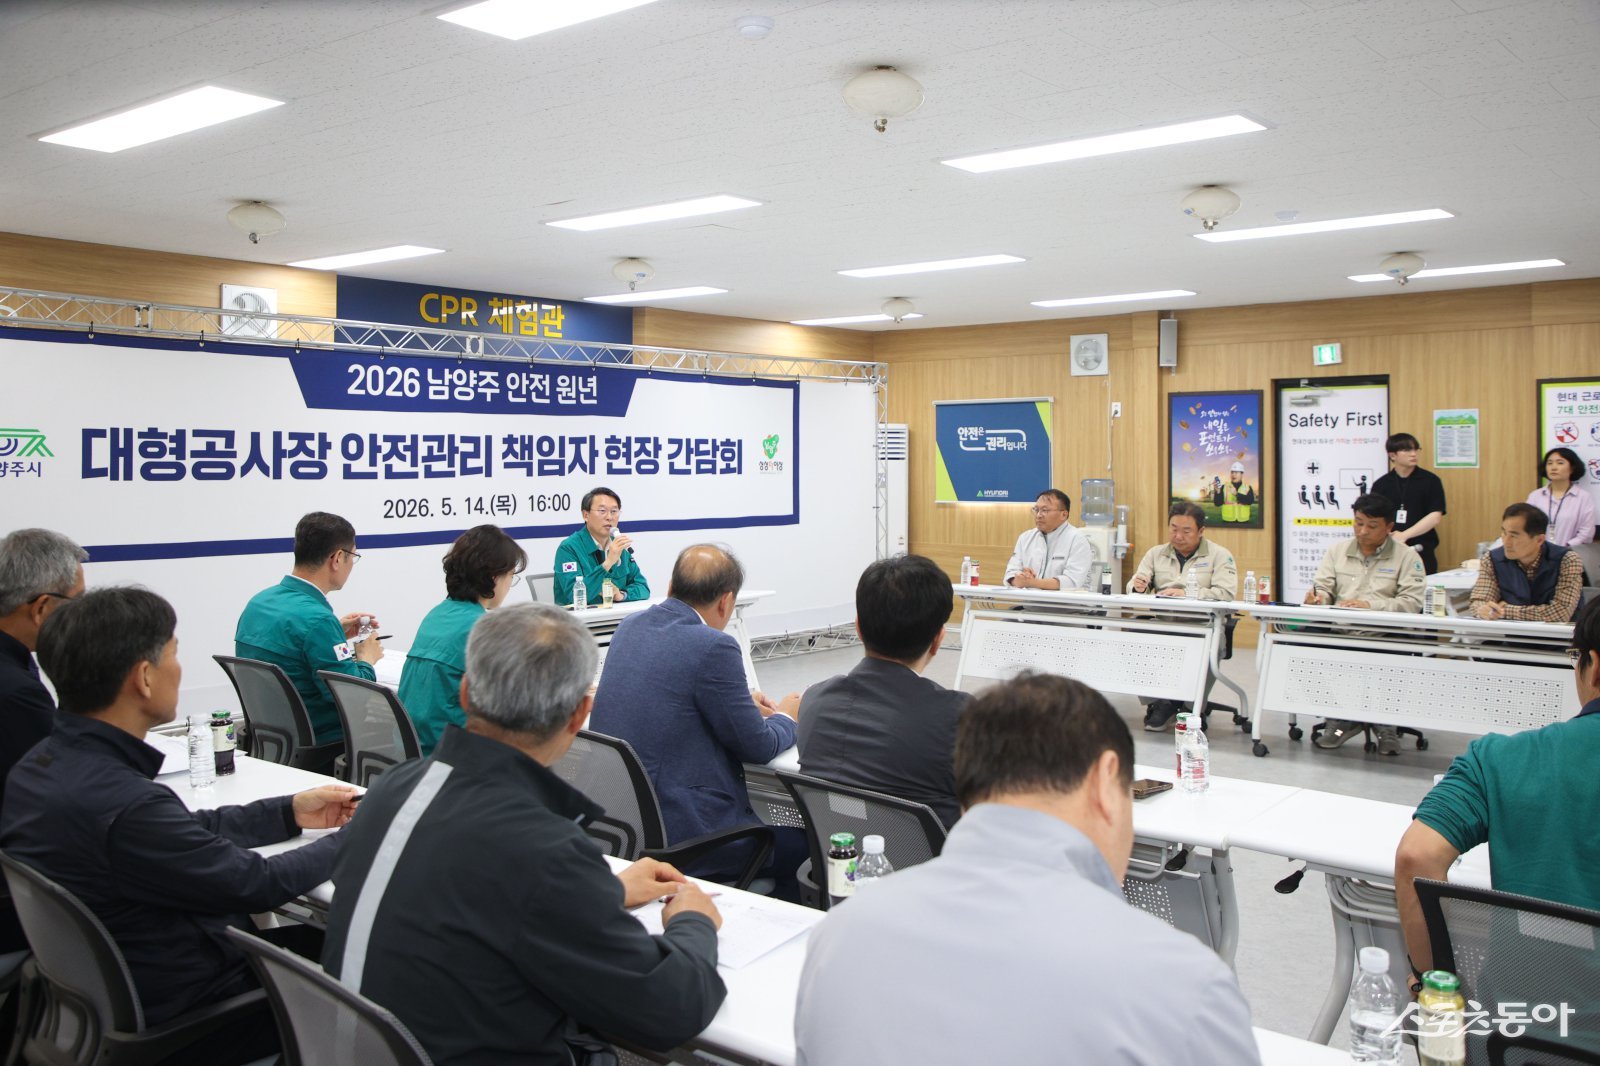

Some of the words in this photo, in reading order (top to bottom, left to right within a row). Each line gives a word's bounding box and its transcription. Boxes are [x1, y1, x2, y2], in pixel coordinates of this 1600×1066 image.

[419, 292, 479, 327] CPR
[488, 297, 565, 339] 체험관
[347, 364, 420, 398] 2026
[427, 367, 500, 403] 남양주
[506, 372, 551, 404] 안전
[556, 374, 598, 405] 원년
[1557, 392, 1578, 402] 현대
[1578, 403, 1600, 415] 안전
[1288, 412, 1339, 429] Safety
[1346, 411, 1383, 426] First
[957, 426, 985, 441] 안전은
[985, 436, 1028, 451] 권리입니다
[81, 427, 332, 482] 대형공사장
[341, 432, 493, 481] 안전관리
[501, 434, 599, 479] 책임자
[604, 435, 662, 476] 현장
[667, 436, 743, 476] 간담회
[383, 499, 434, 519] 2026.
[441, 498, 457, 517] 5.
[465, 493, 517, 516] 14.(목)
[528, 493, 570, 512] 16:00
